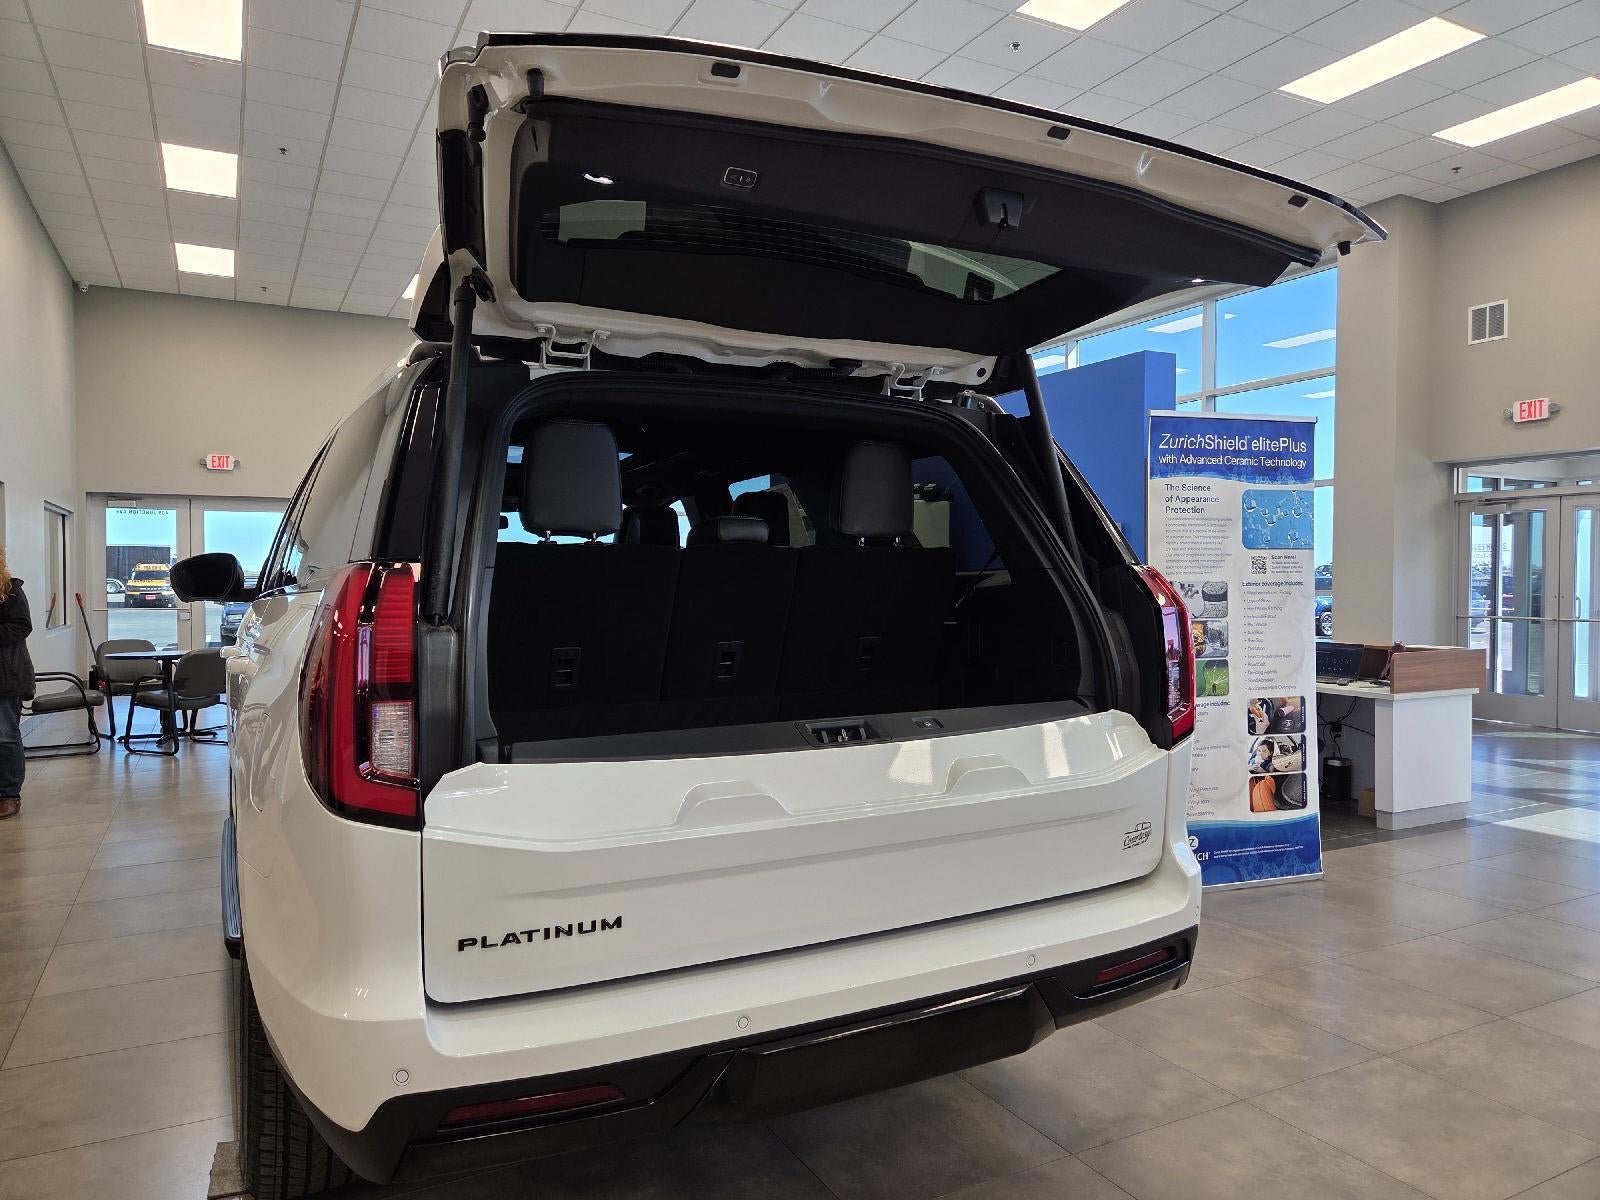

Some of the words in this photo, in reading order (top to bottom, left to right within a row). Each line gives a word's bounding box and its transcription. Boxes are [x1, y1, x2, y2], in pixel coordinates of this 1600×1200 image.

[1519, 399, 1544, 420] EXIT
[1158, 433, 1248, 451] ZurichShield
[1251, 436, 1307, 453] elitePlus
[211, 455, 230, 469] EXIT
[1158, 453, 1177, 464] with
[1179, 453, 1223, 465] Advanced
[1224, 455, 1259, 466] Ceramic
[1259, 456, 1307, 469] Technology
[1164, 483, 1180, 492] The
[1181, 483, 1211, 492] Science
[1164, 495, 1174, 503] of
[1175, 495, 1219, 504] Appearance
[1165, 505, 1205, 514] Protection
[457, 915, 623, 952] PLATINUM
